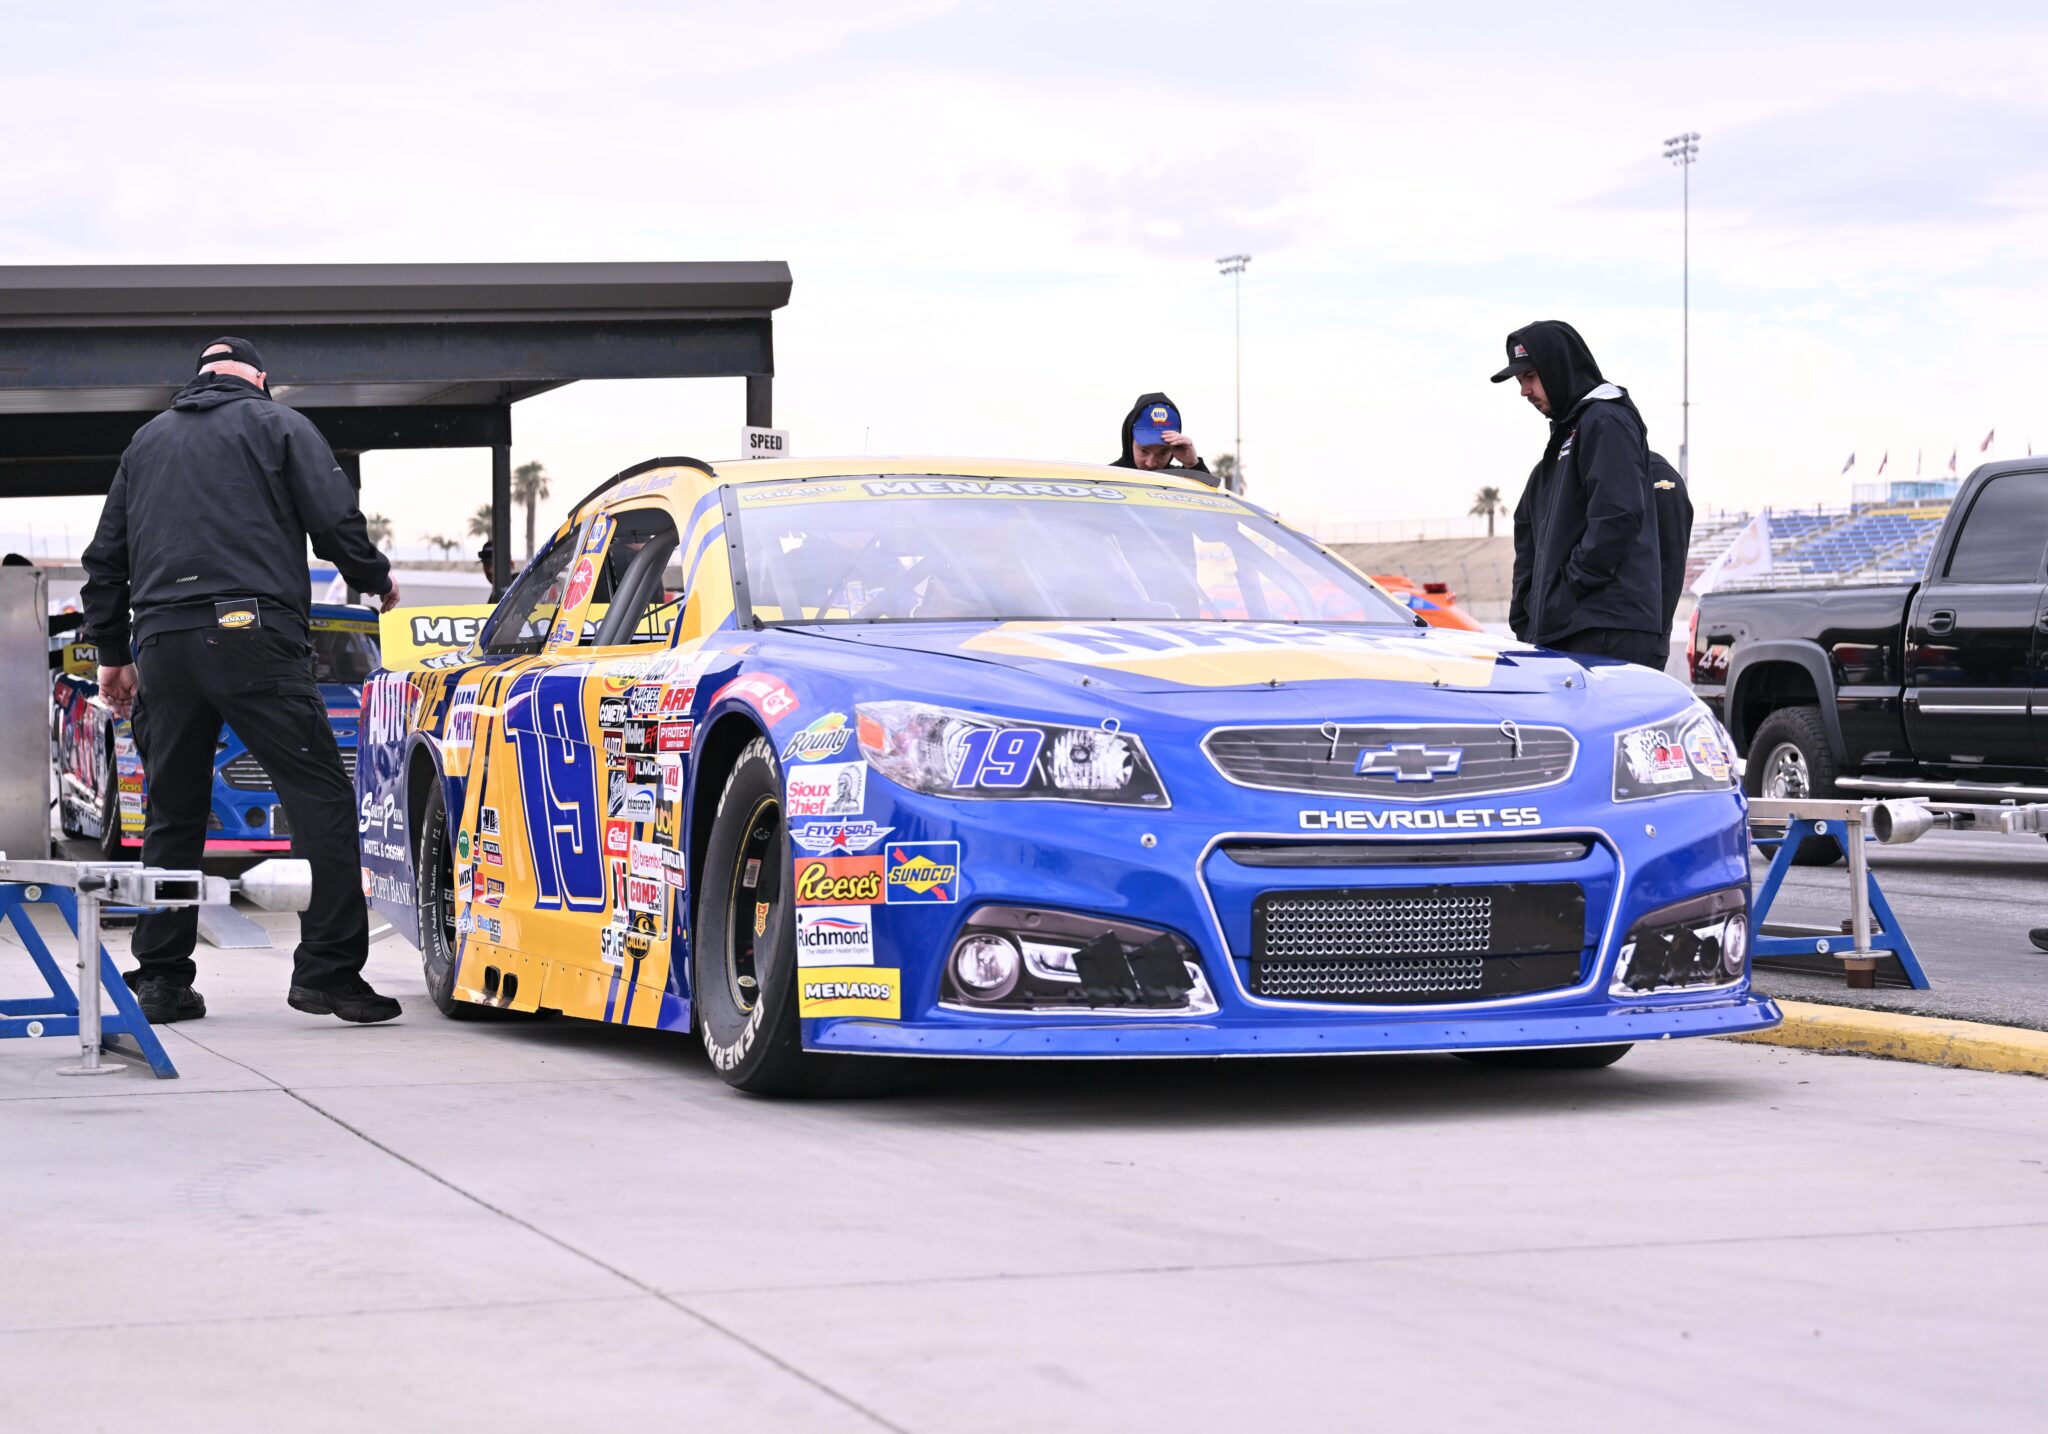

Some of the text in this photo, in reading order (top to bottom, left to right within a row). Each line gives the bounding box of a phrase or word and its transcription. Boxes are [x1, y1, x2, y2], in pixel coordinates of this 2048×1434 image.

[750, 433, 783, 450] SPEED
[743, 485, 848, 501] MENARDS
[861, 480, 1127, 500] MENARDS
[218, 614, 256, 623] MENARDS
[633, 686, 661, 700] QUARTER
[660, 687, 696, 712] ARP
[369, 671, 410, 745] AUTO
[599, 703, 628, 723] COMETIC
[625, 722, 646, 751] Holley
[660, 726, 691, 739] PYROTECT
[780, 727, 855, 763] Bounty
[951, 728, 1045, 789] 19
[717, 735, 777, 818] GENERAL
[504, 661, 607, 913] 19
[788, 781, 831, 798] Sioux
[787, 798, 826, 816] Chief
[1298, 806, 1542, 830] CHEVROLET SS
[806, 824, 874, 837] FIVE STAR
[458, 869, 472, 887] WIX
[890, 867, 952, 883] SUNOCO
[371, 871, 412, 906] POPPY BANK
[630, 880, 657, 904] COMP
[798, 923, 869, 947] Richmond
[804, 982, 890, 999] MENARDS
[703, 991, 764, 1073] GENERAL
